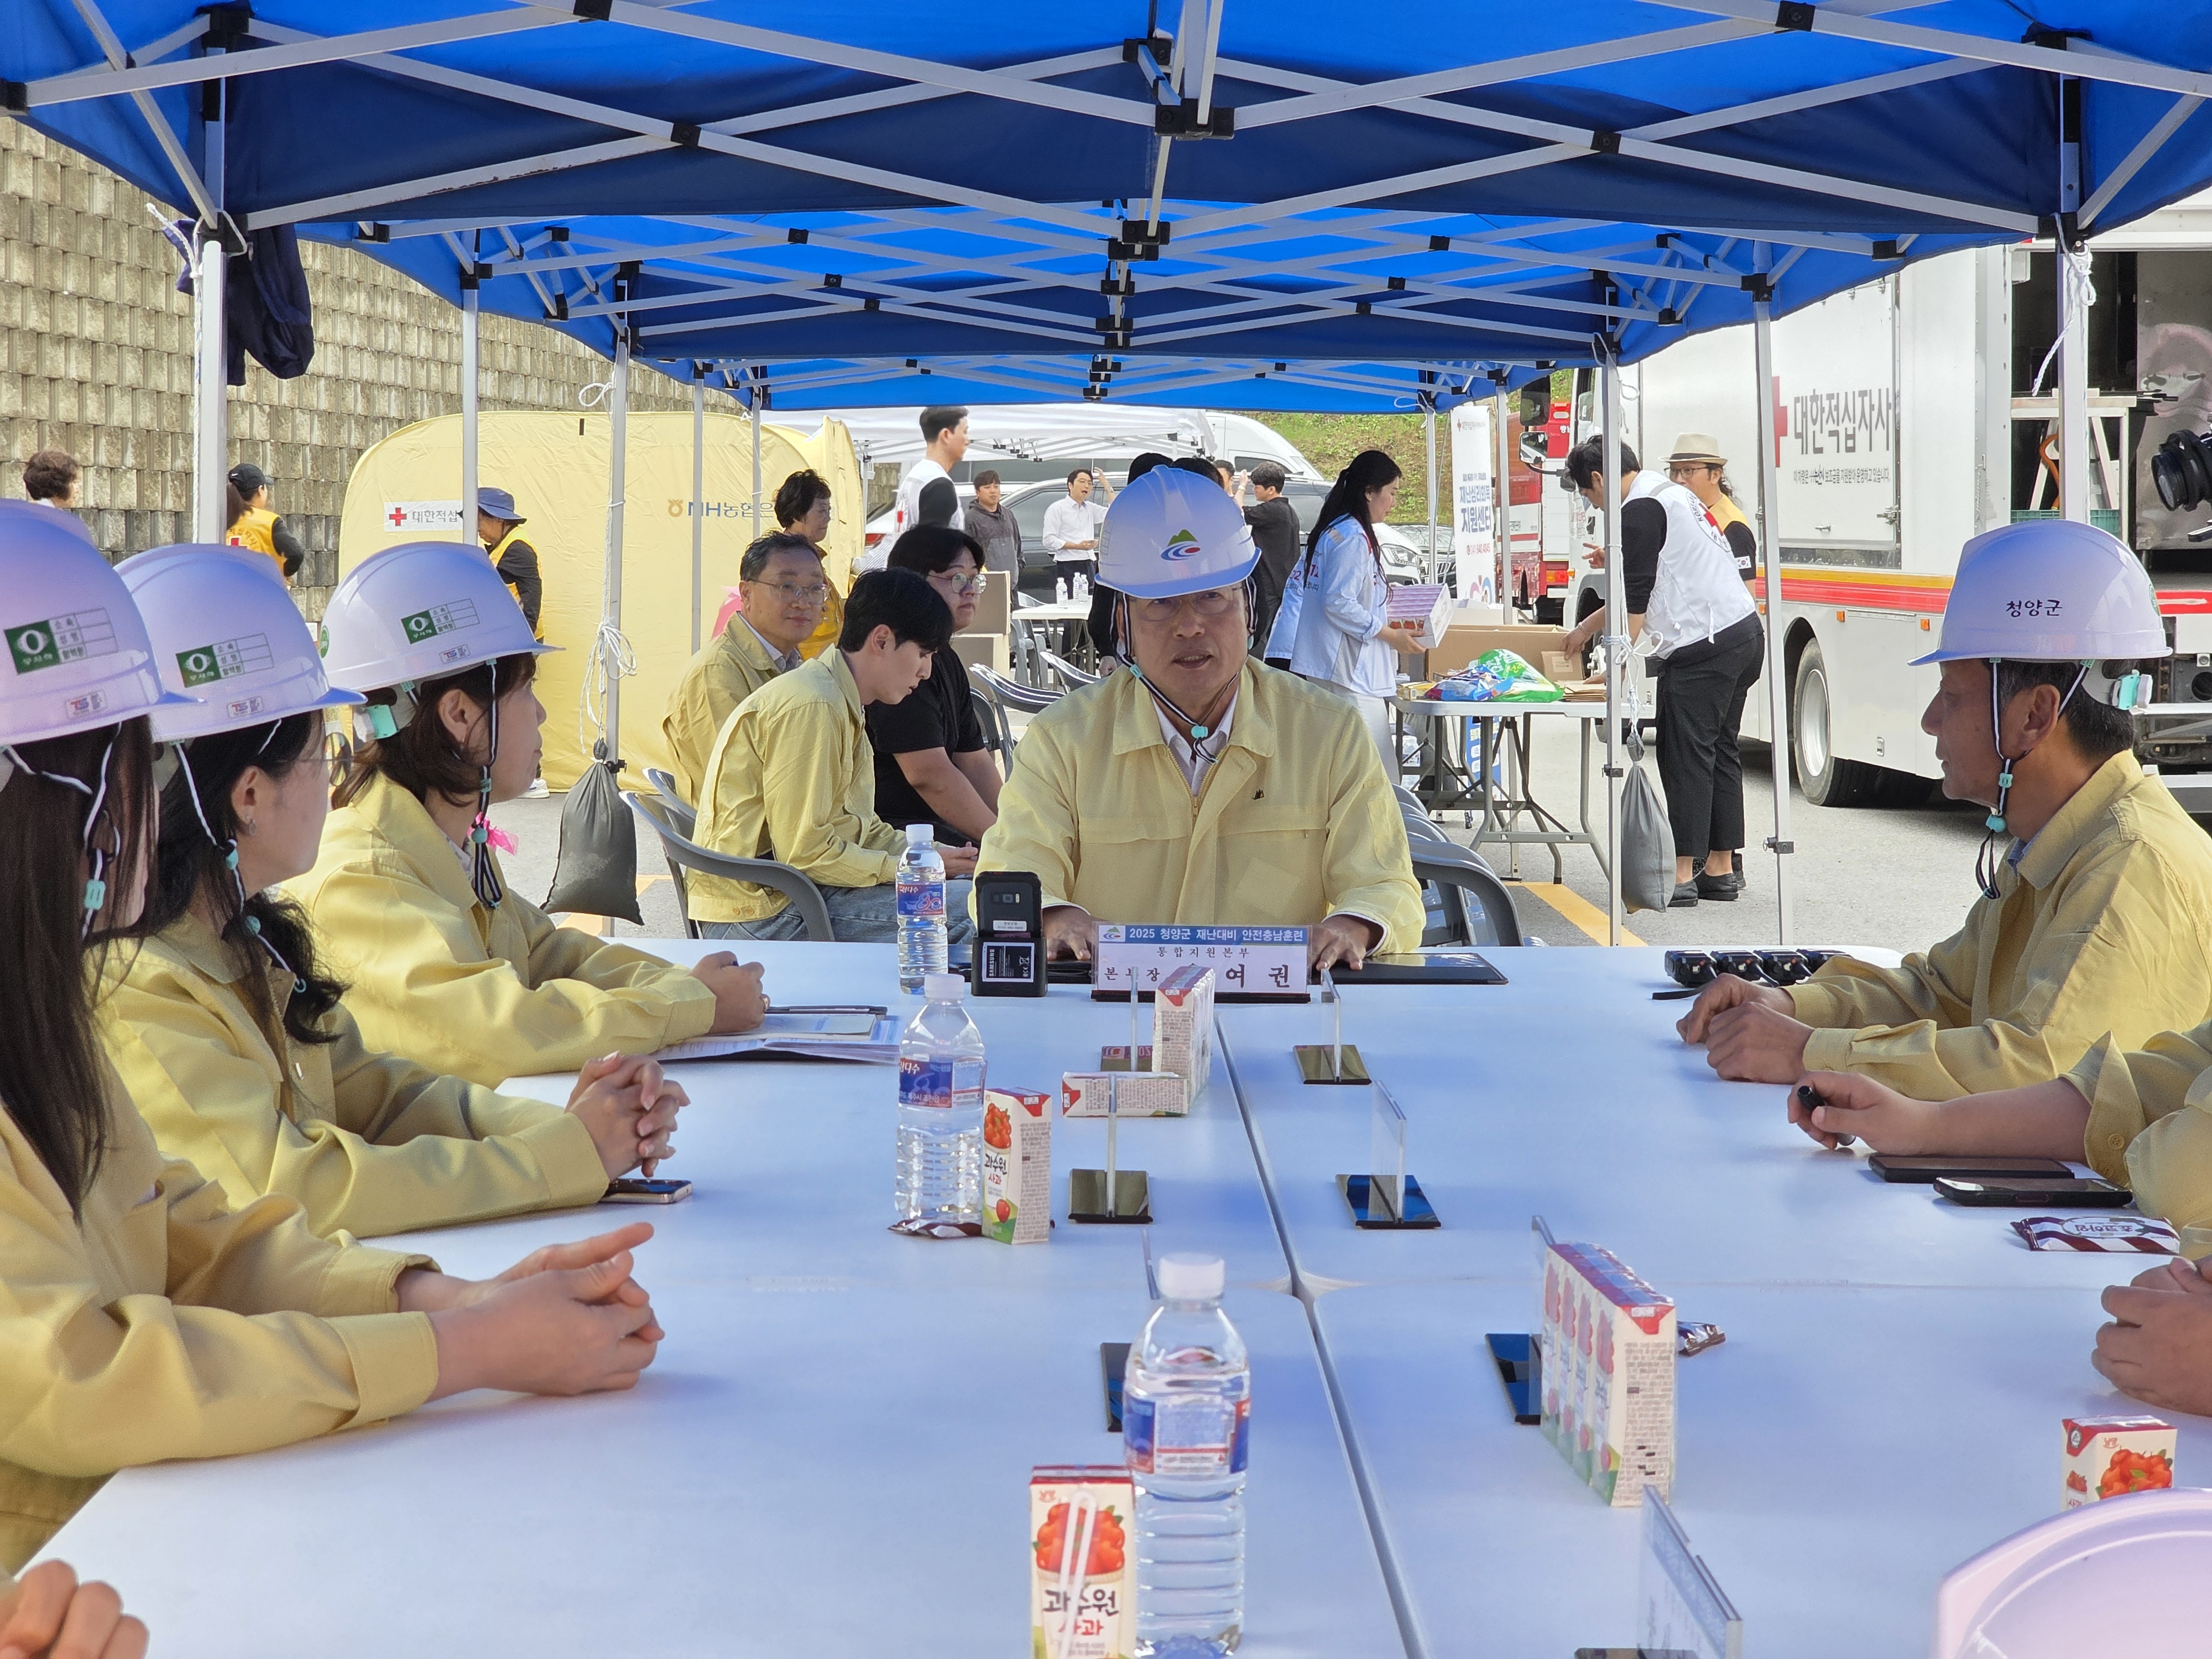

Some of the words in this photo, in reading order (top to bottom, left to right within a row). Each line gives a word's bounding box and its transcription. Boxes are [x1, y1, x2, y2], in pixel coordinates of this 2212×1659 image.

[1794, 388, 1892, 455] 대한적십자사
[1459, 484, 1490, 504] 재난심리회복
[1461, 505, 1491, 533] 지원센터
[2006, 599, 2062, 617] 청양군
[1129, 928, 1155, 938] 2025
[1160, 928, 1191, 940] 청양군
[1196, 929, 1237, 941] 재난대비
[1242, 929, 1303, 941] 안전충남훈련
[1225, 963, 1290, 988] 여권
[984, 1151, 1008, 1175] 과수원
[988, 1172, 1002, 1185] 사과
[1042, 1588, 1120, 1616] 과수원
